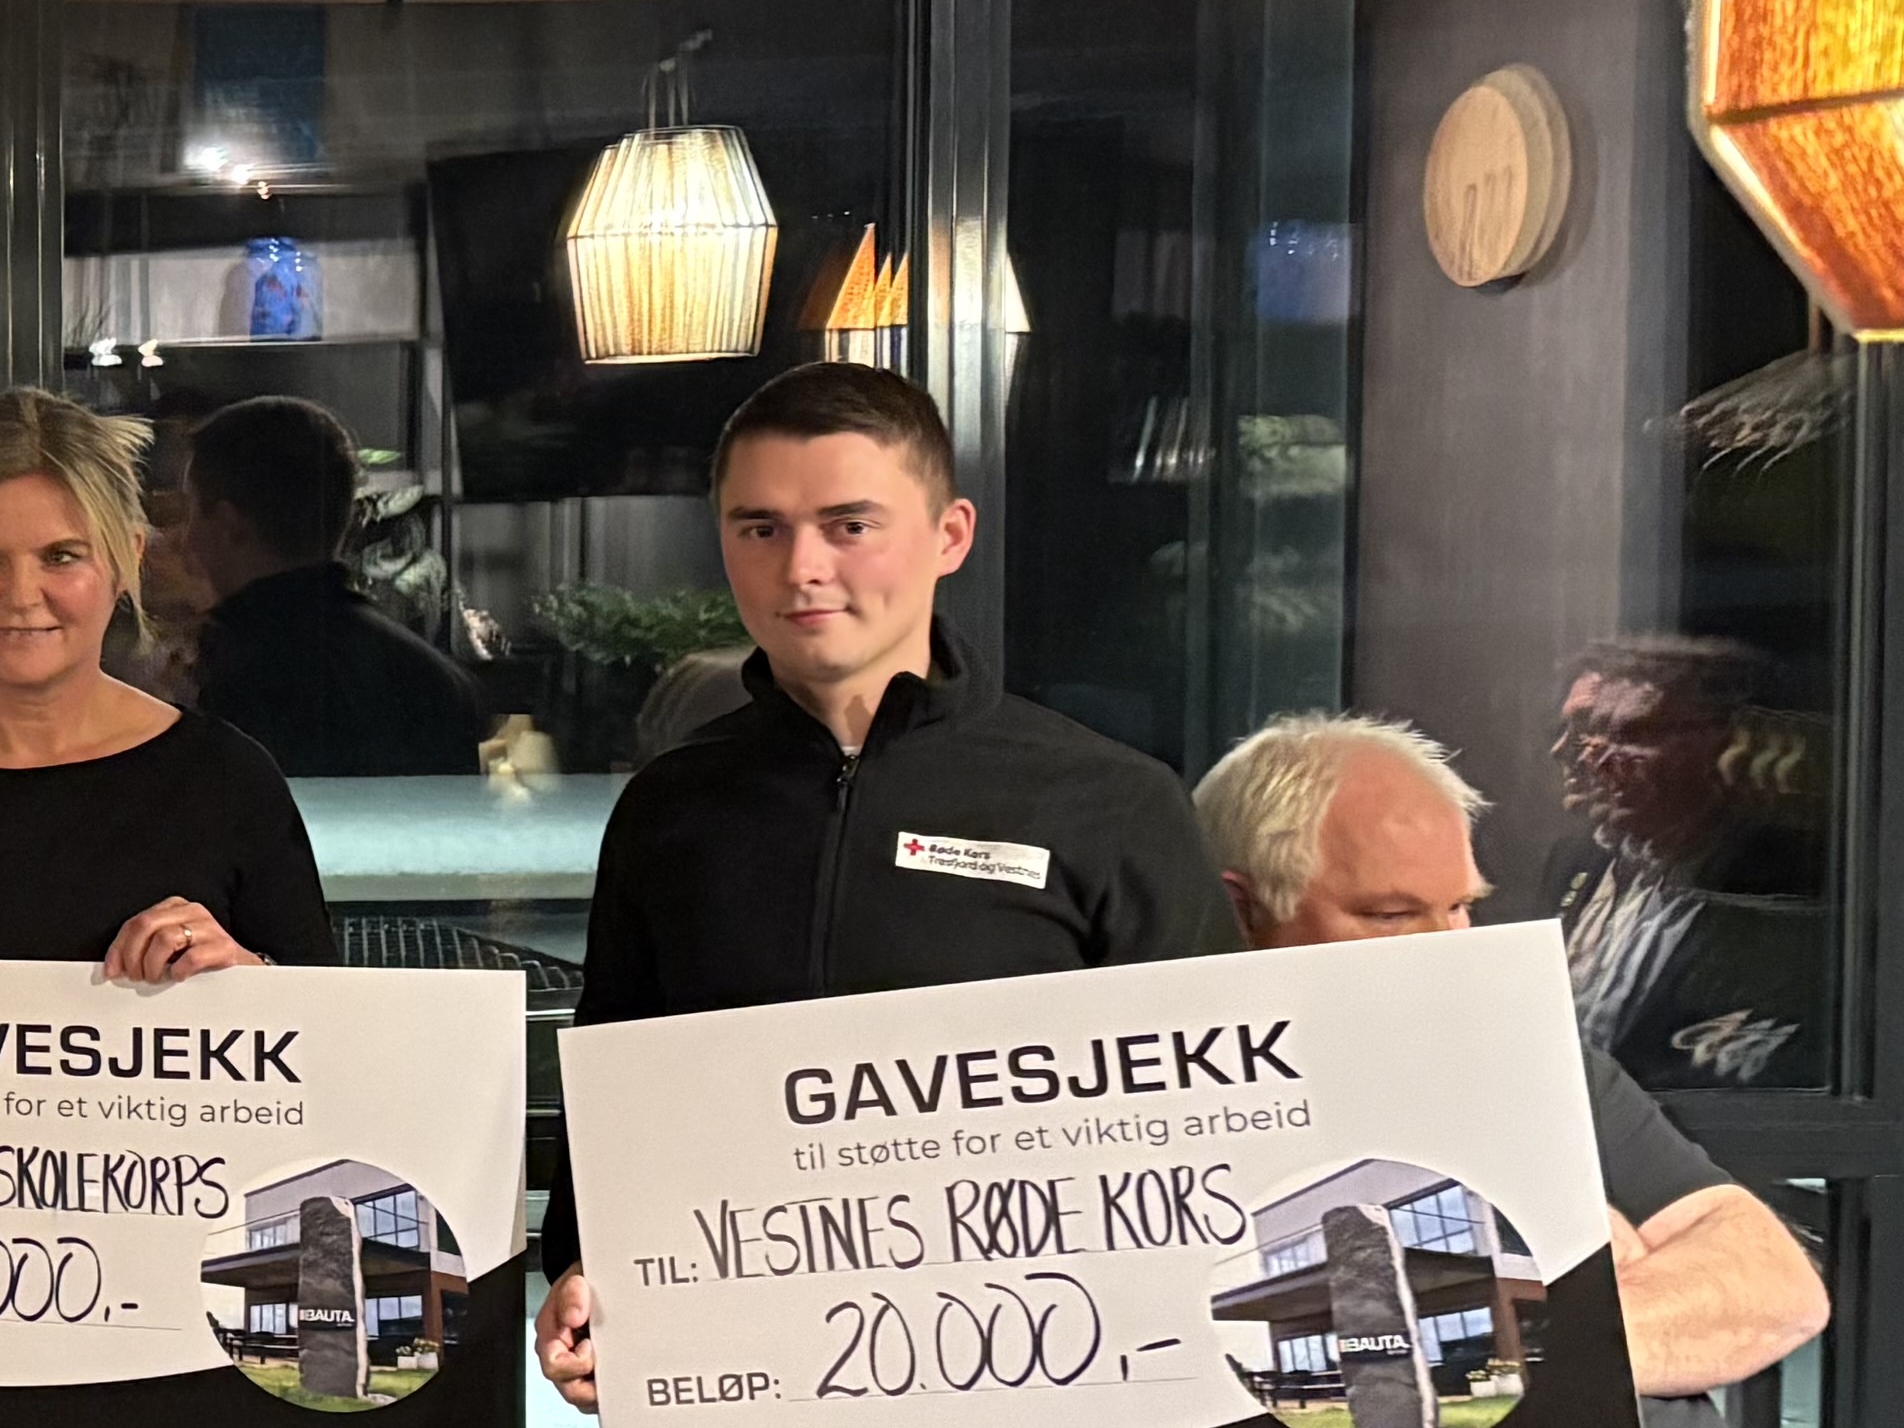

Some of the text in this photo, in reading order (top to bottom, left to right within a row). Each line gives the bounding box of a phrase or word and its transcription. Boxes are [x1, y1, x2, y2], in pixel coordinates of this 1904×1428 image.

[3, 1090, 47, 1117] for
[57, 1097, 88, 1119] et
[97, 1094, 187, 1128] viktig
[199, 1098, 304, 1126] arbeid
[783, 1019, 1304, 1126] GAVESJEKK
[793, 1098, 1311, 1171] til støtte for et viktig arbeid
[633, 1164, 1250, 1287] TIL: VESTNES RØDE KORS
[646, 1371, 782, 1407] BELØP:
